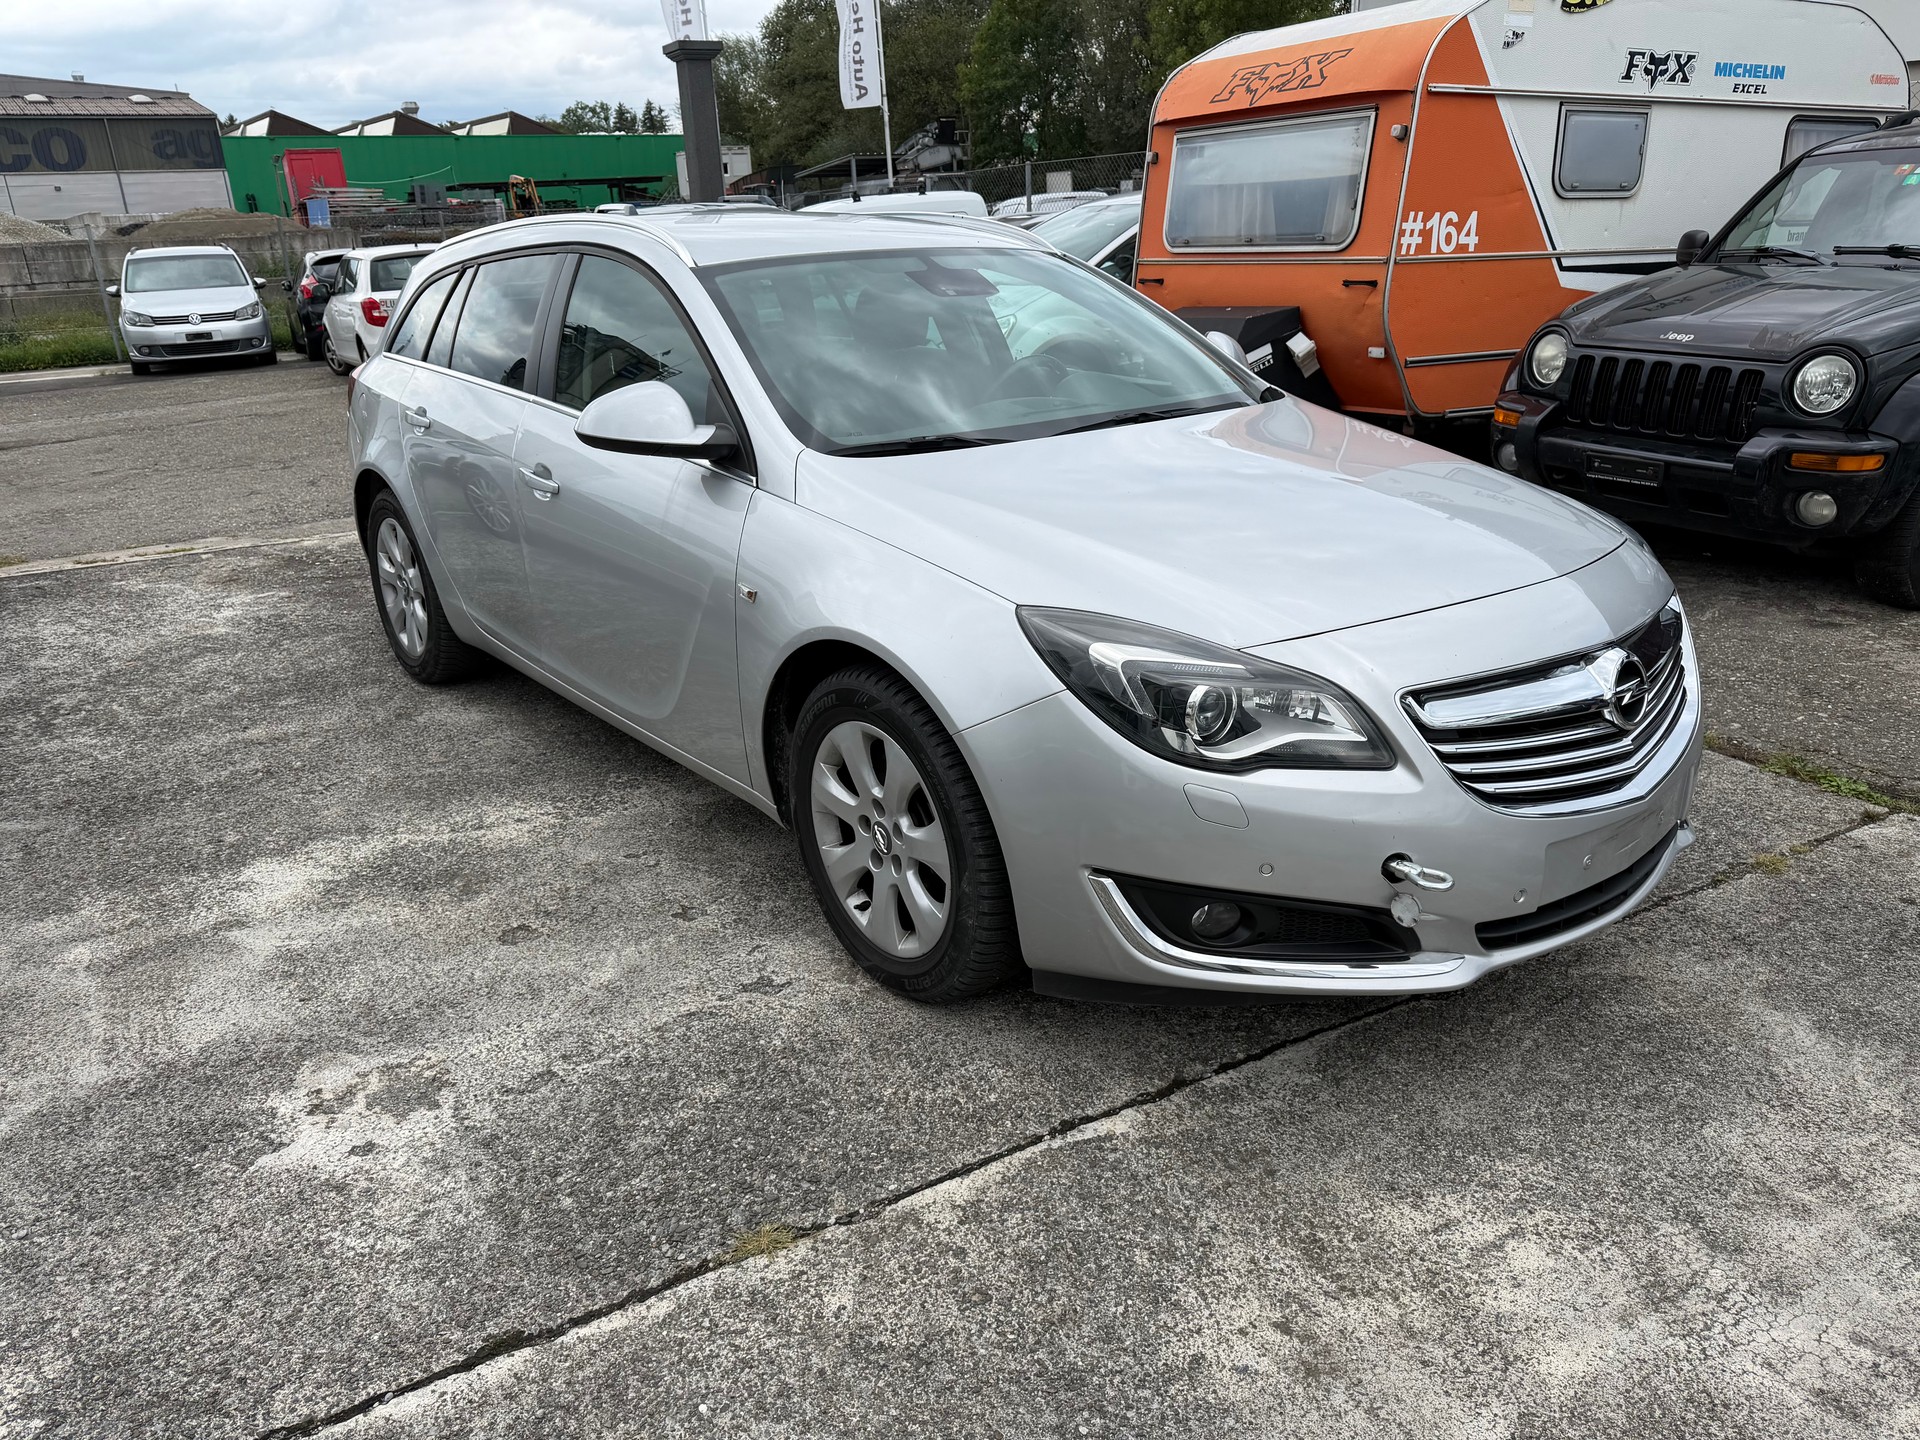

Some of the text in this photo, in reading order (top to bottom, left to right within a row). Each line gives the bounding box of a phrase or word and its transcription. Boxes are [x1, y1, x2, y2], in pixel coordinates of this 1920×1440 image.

[1619, 48, 1698, 93] FOX
[1714, 62, 1786, 80] MICHELIN
[1732, 83, 1768, 95] EXCEL
[1400, 210, 1479, 254] #164
[1787, 230, 1808, 242] bran
[1660, 331, 1695, 342] Jeep
